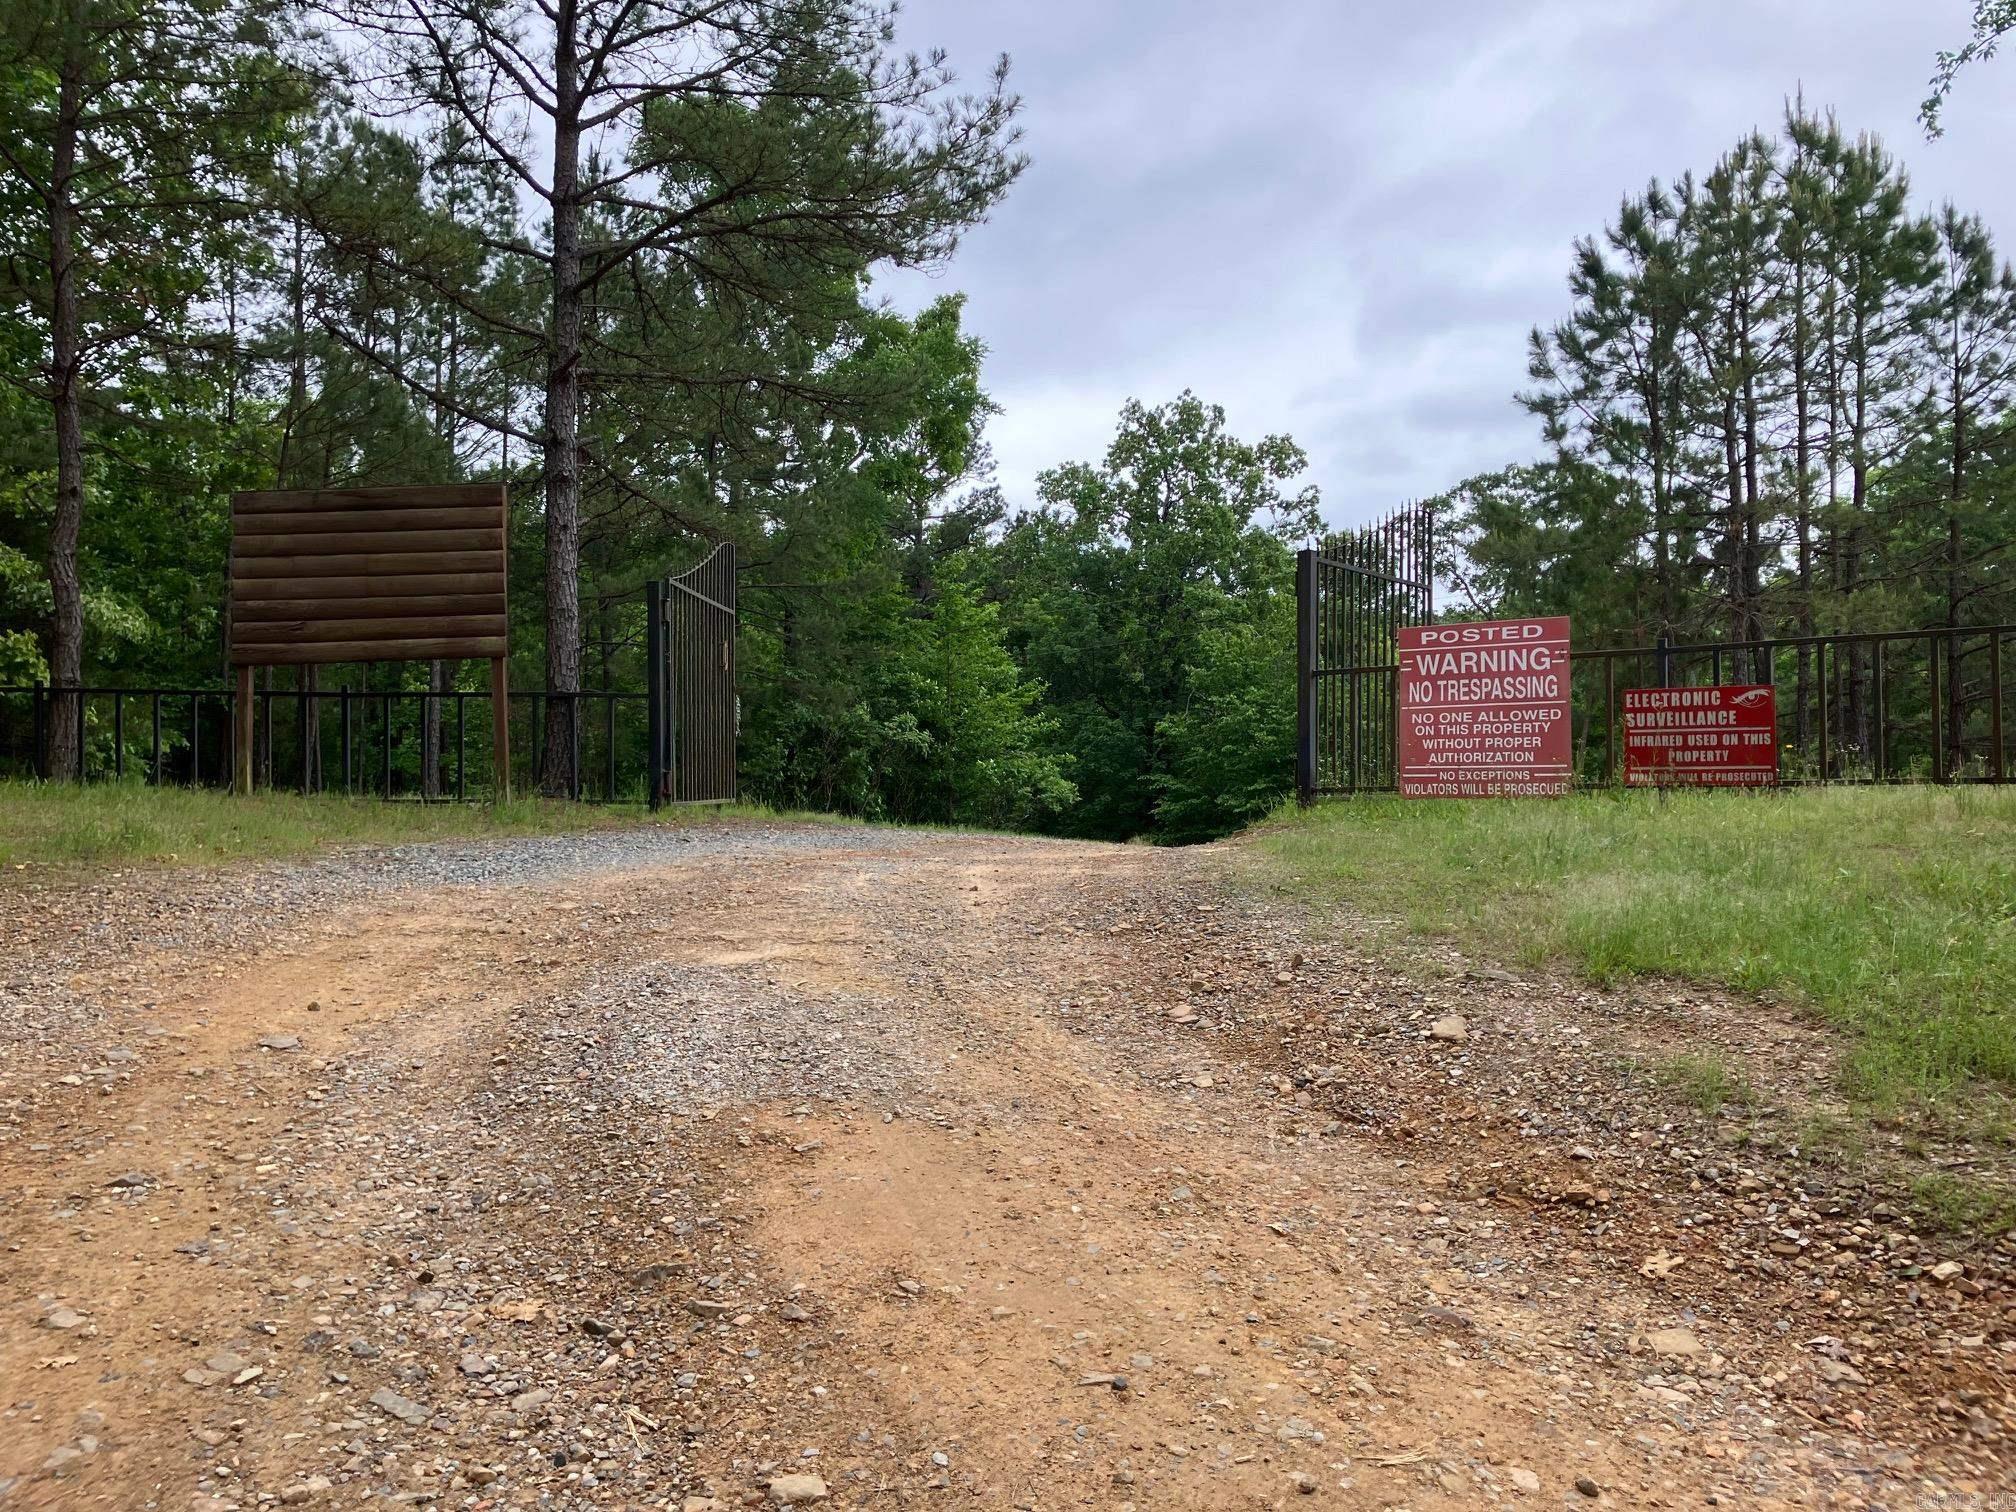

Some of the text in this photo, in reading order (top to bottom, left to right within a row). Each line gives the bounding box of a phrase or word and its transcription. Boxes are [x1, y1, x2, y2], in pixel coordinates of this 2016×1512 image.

[1421, 625, 1543, 645] POSTED
[1416, 647, 1551, 675] WARNING
[1409, 675, 1558, 702] NO TRESPASSING
[1626, 691, 1720, 708] ELECTRONIC
[1412, 709, 1561, 724] NO ONE ALLOWED
[1626, 710, 1737, 727] SURVEILLANCE
[1415, 722, 1551, 736] ON THIS PROPERTY
[1422, 737, 1541, 749] WITHOUT PROPER
[1629, 733, 1771, 747] INFRARED USED ON THIS
[1429, 752, 1534, 763] AUTHORIZATION
[1668, 749, 1729, 762] PROPERTY
[1439, 770, 1530, 780] NO EXCEPTIONS
[1702, 772, 1713, 781] BE
[1715, 772, 1773, 782] PROSECUTED
[1405, 784, 1458, 795] VIOLATORS
[1461, 783, 1484, 795] WILL
[1488, 783, 1500, 794] BE
